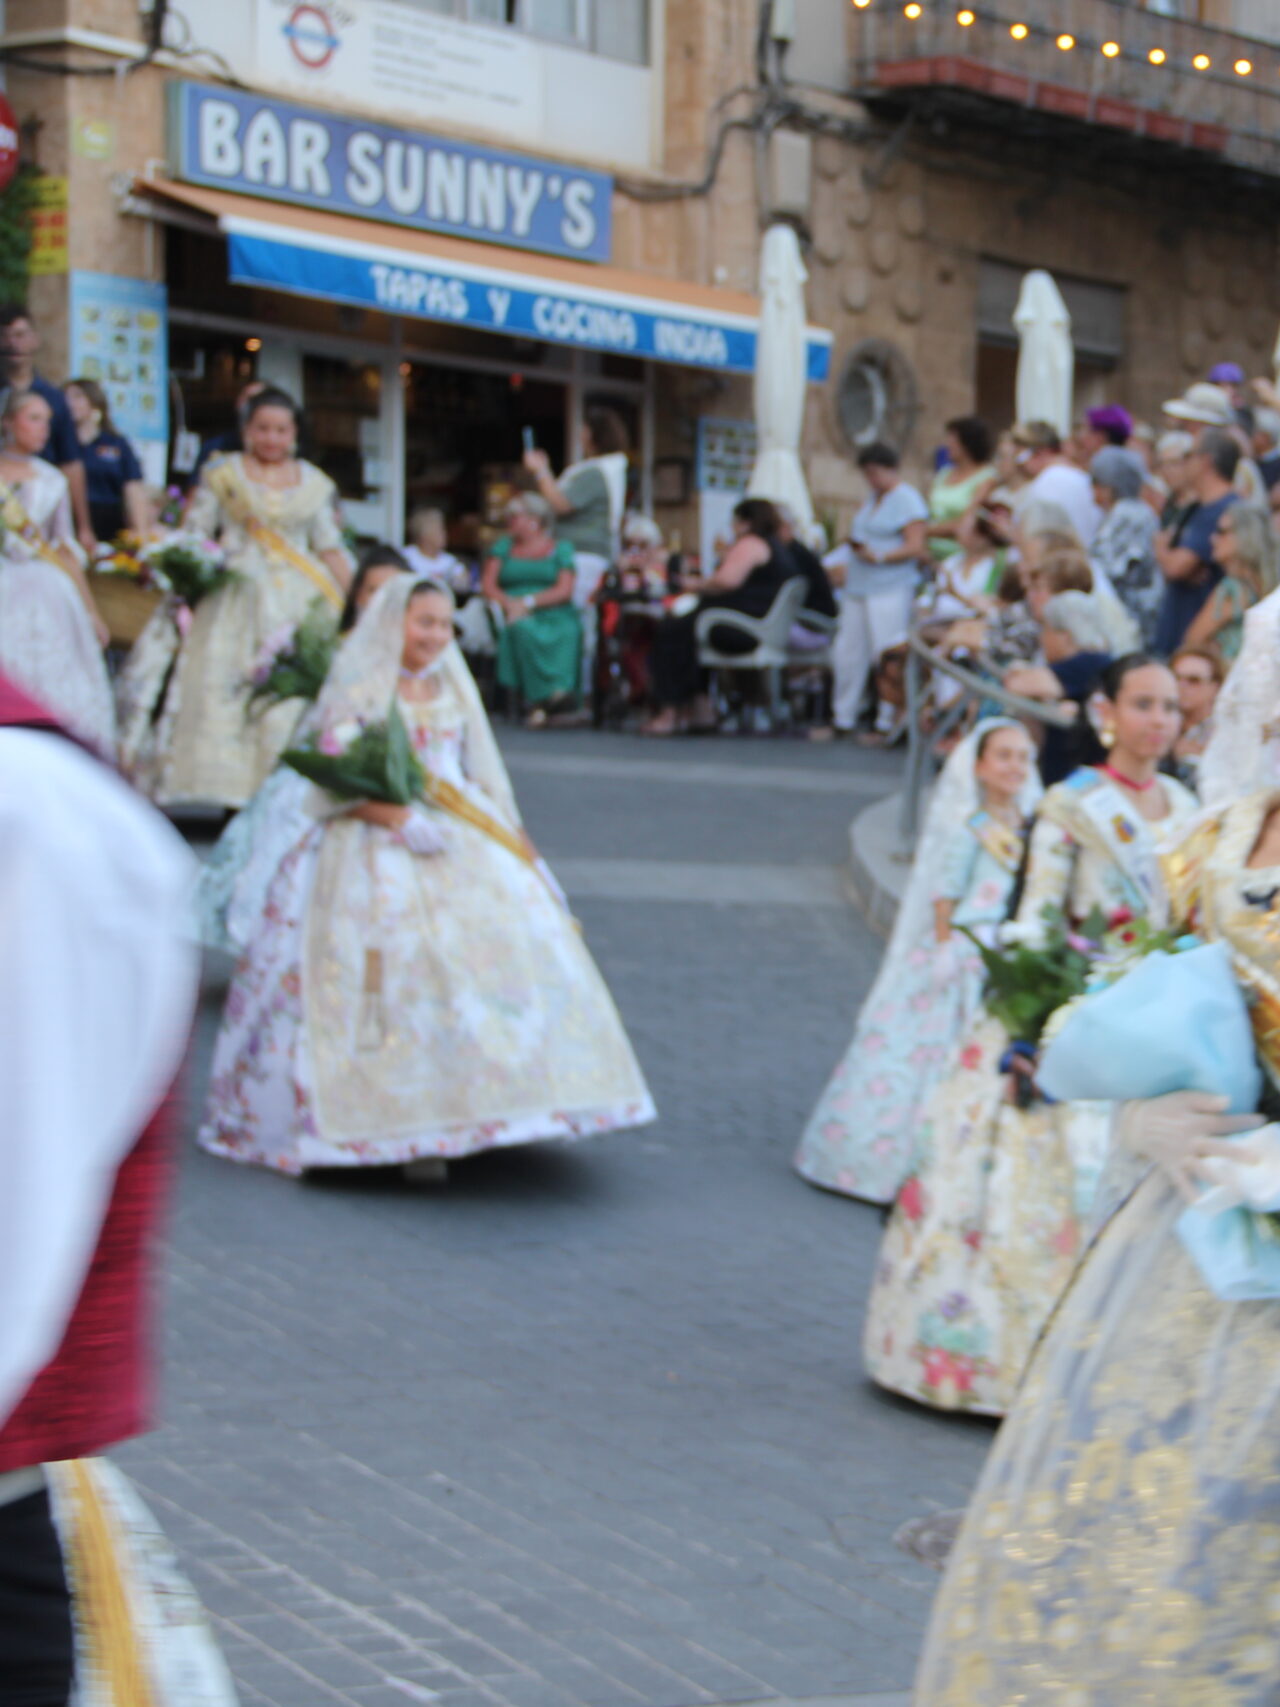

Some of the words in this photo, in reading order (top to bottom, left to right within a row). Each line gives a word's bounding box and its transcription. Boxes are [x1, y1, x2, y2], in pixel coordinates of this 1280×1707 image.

[201, 98, 332, 198] BAR
[345, 131, 597, 250] SUNNY'S
[369, 264, 470, 319] TAPAS
[487, 287, 511, 327] Y
[532, 296, 638, 350] COCINA
[652, 319, 729, 366] INDIA
